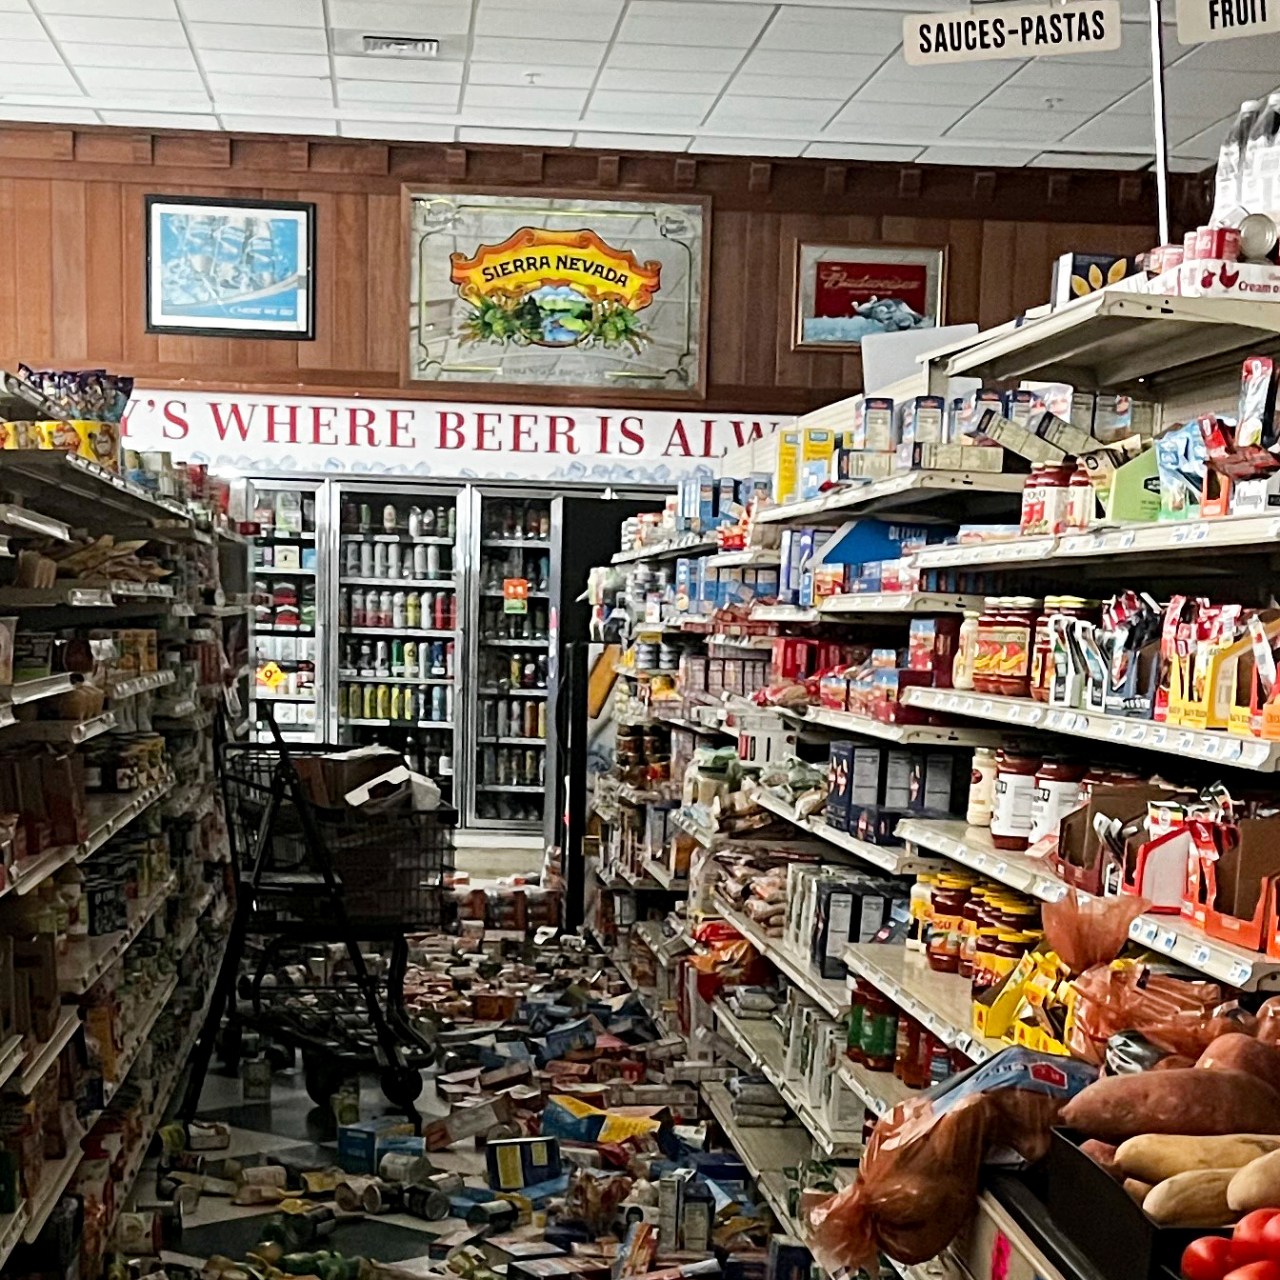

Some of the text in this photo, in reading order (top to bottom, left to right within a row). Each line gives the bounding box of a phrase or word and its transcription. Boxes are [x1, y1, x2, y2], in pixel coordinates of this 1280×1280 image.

[1208, 0, 1268, 29] FRUIT
[919, 10, 1105, 54] SAUCES-PASTAS
[482, 255, 629, 288] SIERRA NEVADA
[1239, 280, 1269, 293] Cream
[210, 402, 417, 449] WHERE
[435, 411, 578, 455] BEER
[594, 416, 645, 457] IS
